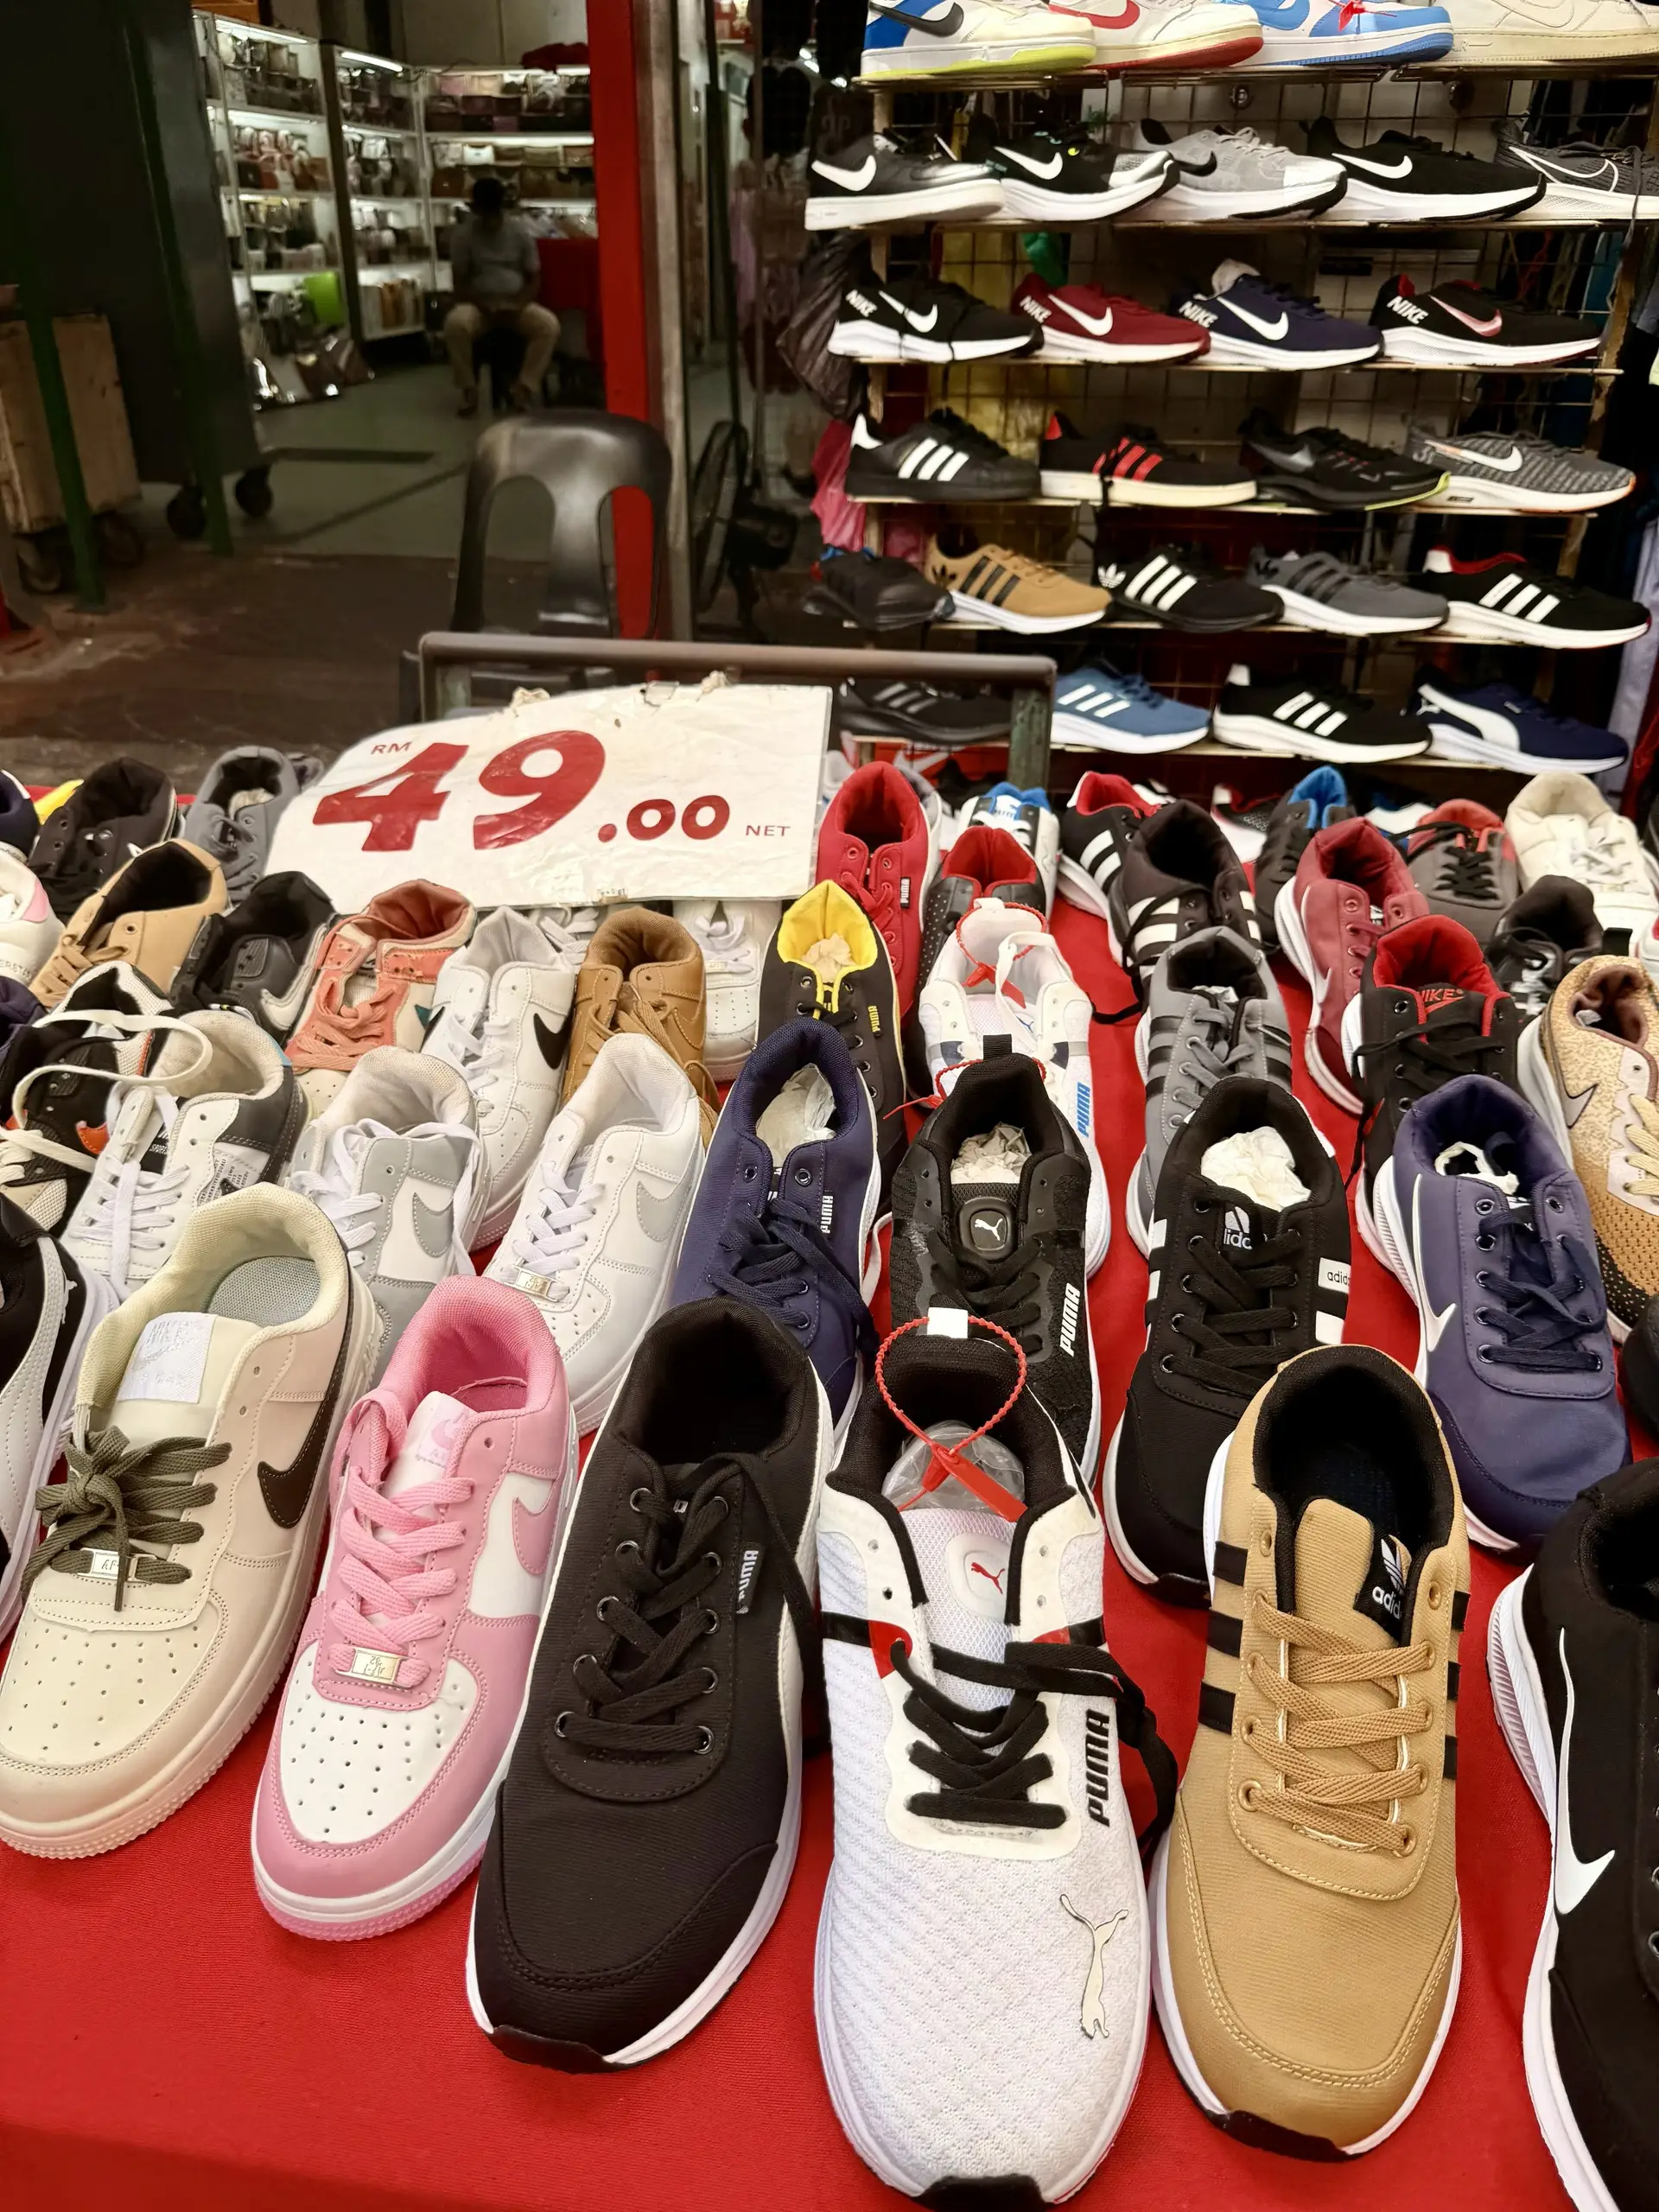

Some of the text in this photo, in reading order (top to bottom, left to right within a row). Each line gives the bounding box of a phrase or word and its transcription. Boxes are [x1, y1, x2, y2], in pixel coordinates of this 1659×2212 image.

[845, 289, 878, 317] NIKE
[1020, 296, 1052, 324] NIKE
[1179, 301, 1218, 327] NIKE
[1386, 296, 1429, 324] NIKE
[371, 741, 411, 755] RM
[746, 825, 791, 838] NET
[868, 1005, 880, 1033] PUMA
[1077, 1082, 1090, 1138] PUMA
[820, 1195, 834, 1234] PUMA
[1059, 1282, 1080, 1357] PUMA
[738, 1550, 760, 1602] PUMA
[1085, 1708, 1110, 1827] PUMA
